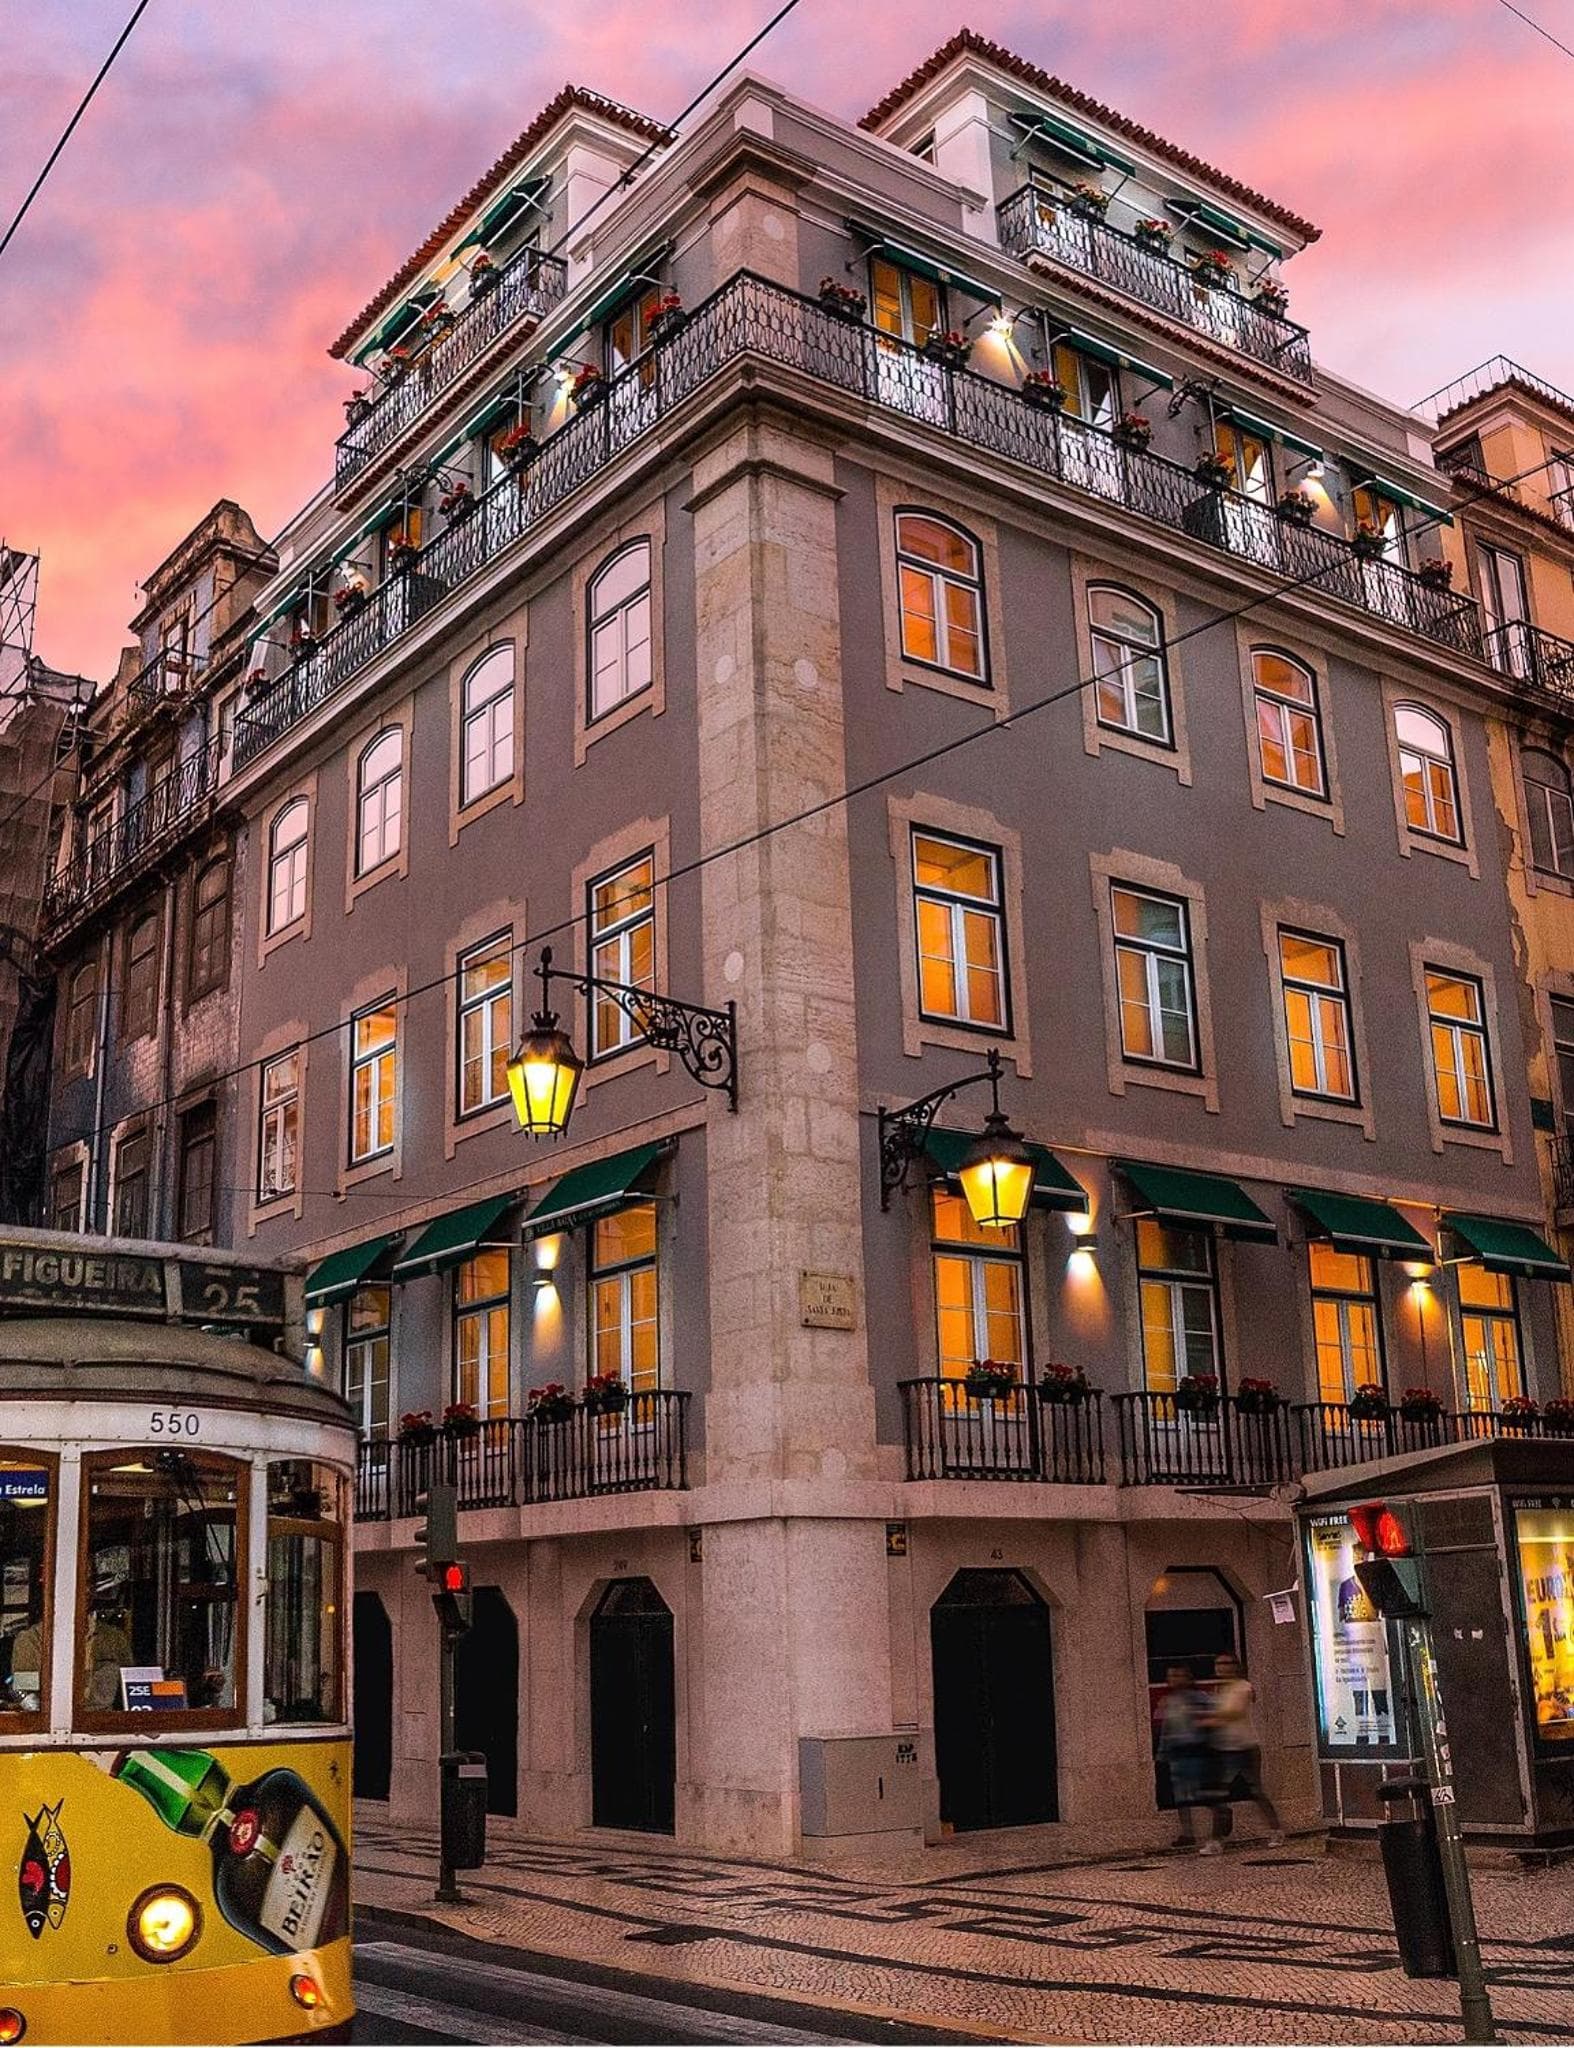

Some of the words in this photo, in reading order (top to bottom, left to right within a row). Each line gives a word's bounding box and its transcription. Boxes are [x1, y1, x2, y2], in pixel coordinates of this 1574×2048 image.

[3, 1252, 162, 1294] FIGUEIRA
[203, 1283, 260, 1316] 25
[150, 1412, 200, 1436] 550
[5, 1483, 46, 1495] Estrela
